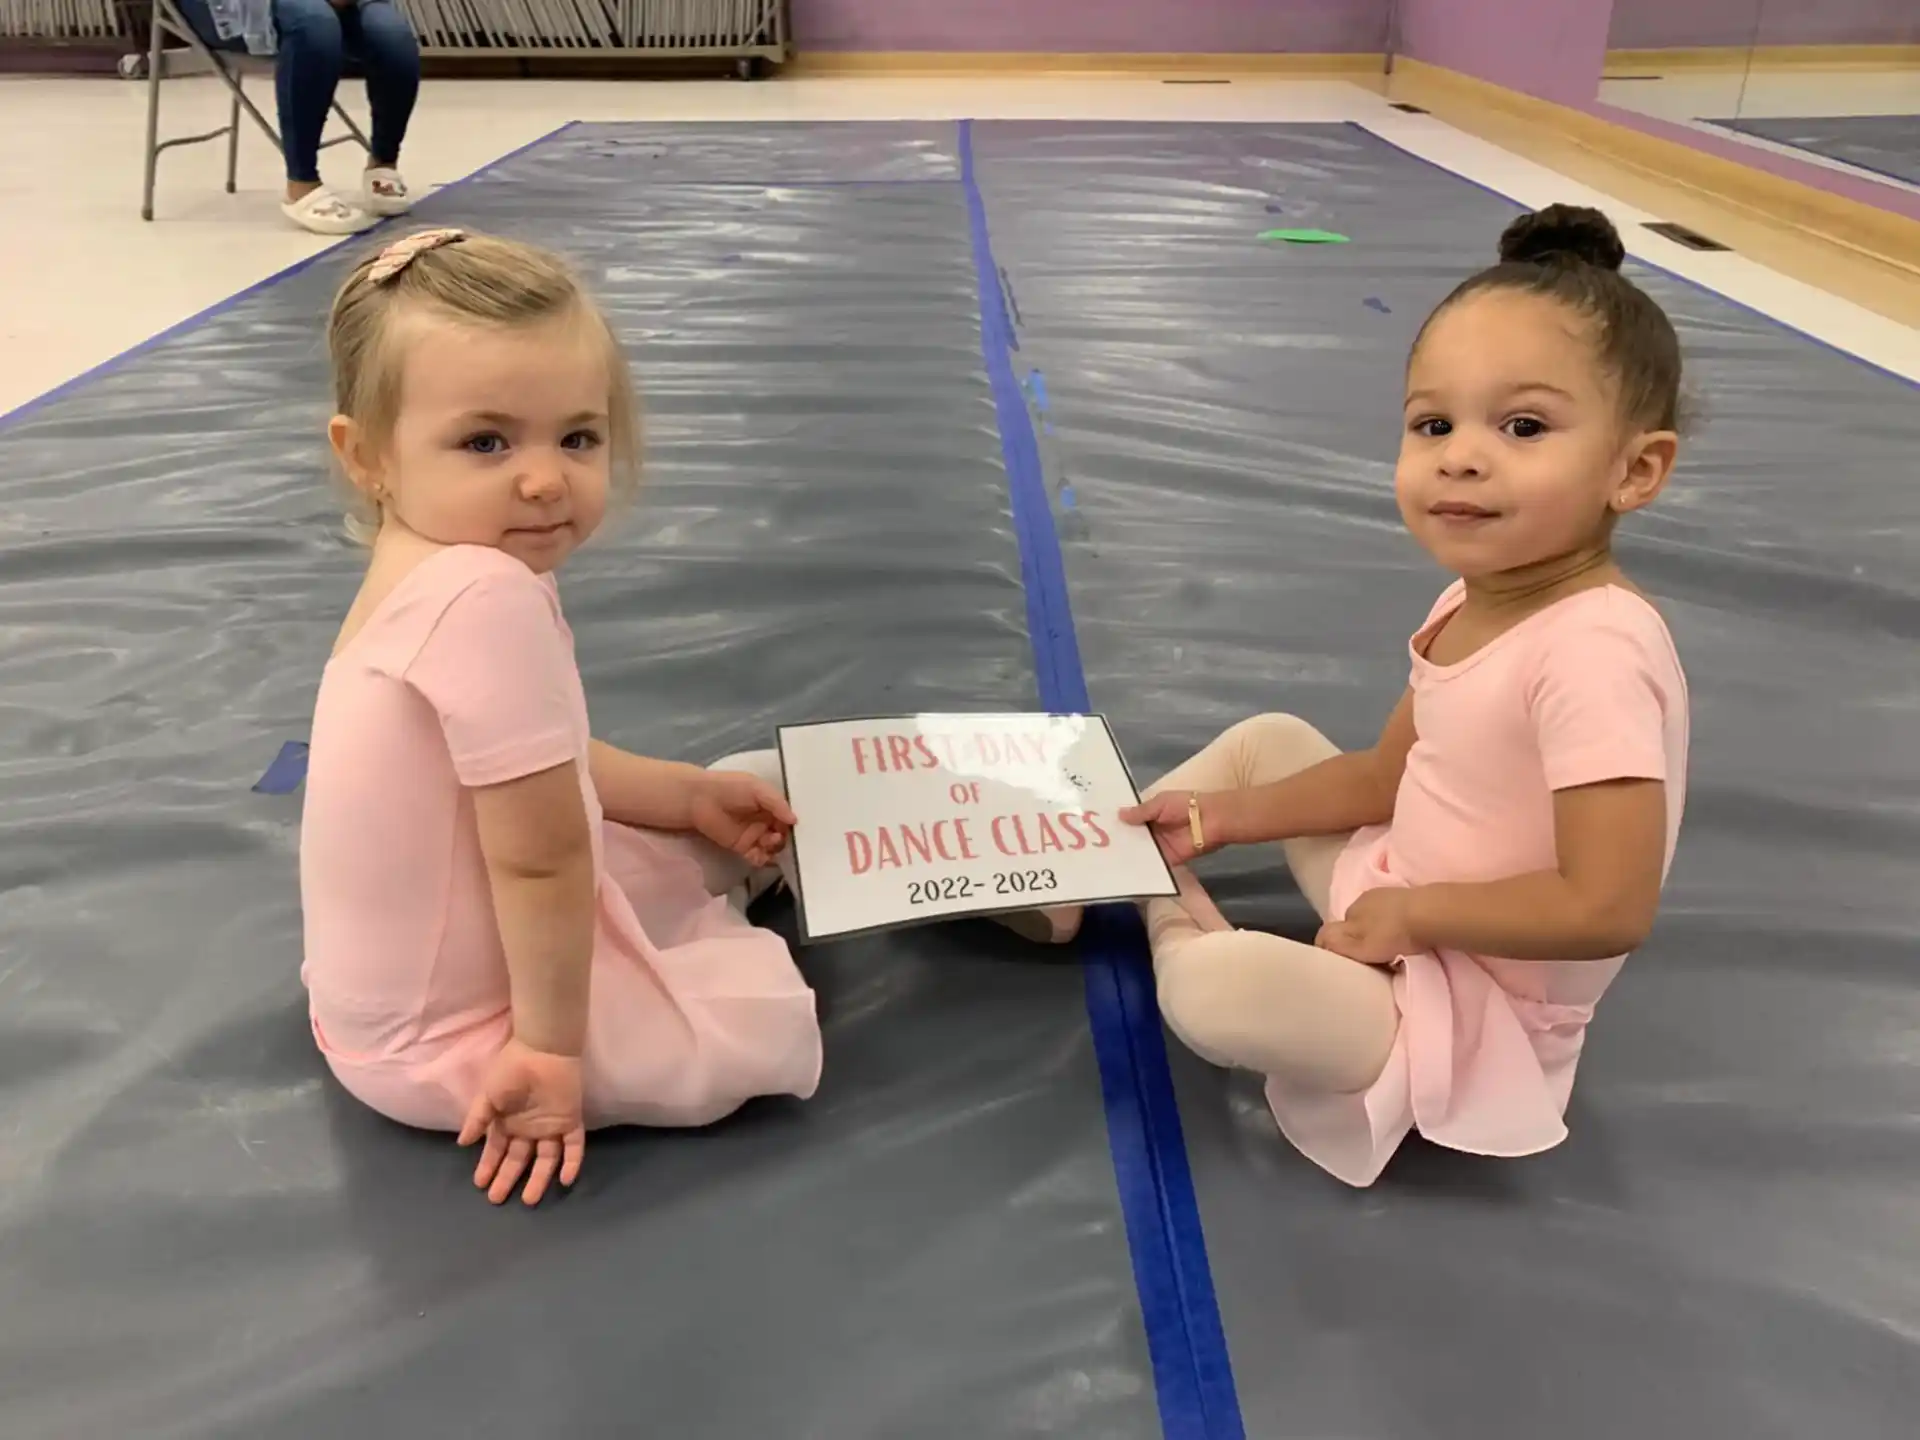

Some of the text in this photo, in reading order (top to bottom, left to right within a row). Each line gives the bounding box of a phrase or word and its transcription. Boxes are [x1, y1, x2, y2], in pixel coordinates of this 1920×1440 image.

[851, 731, 1050, 775] FIRST DAY
[949, 782, 982, 805] OF
[844, 811, 1111, 875] DANCE CLASS
